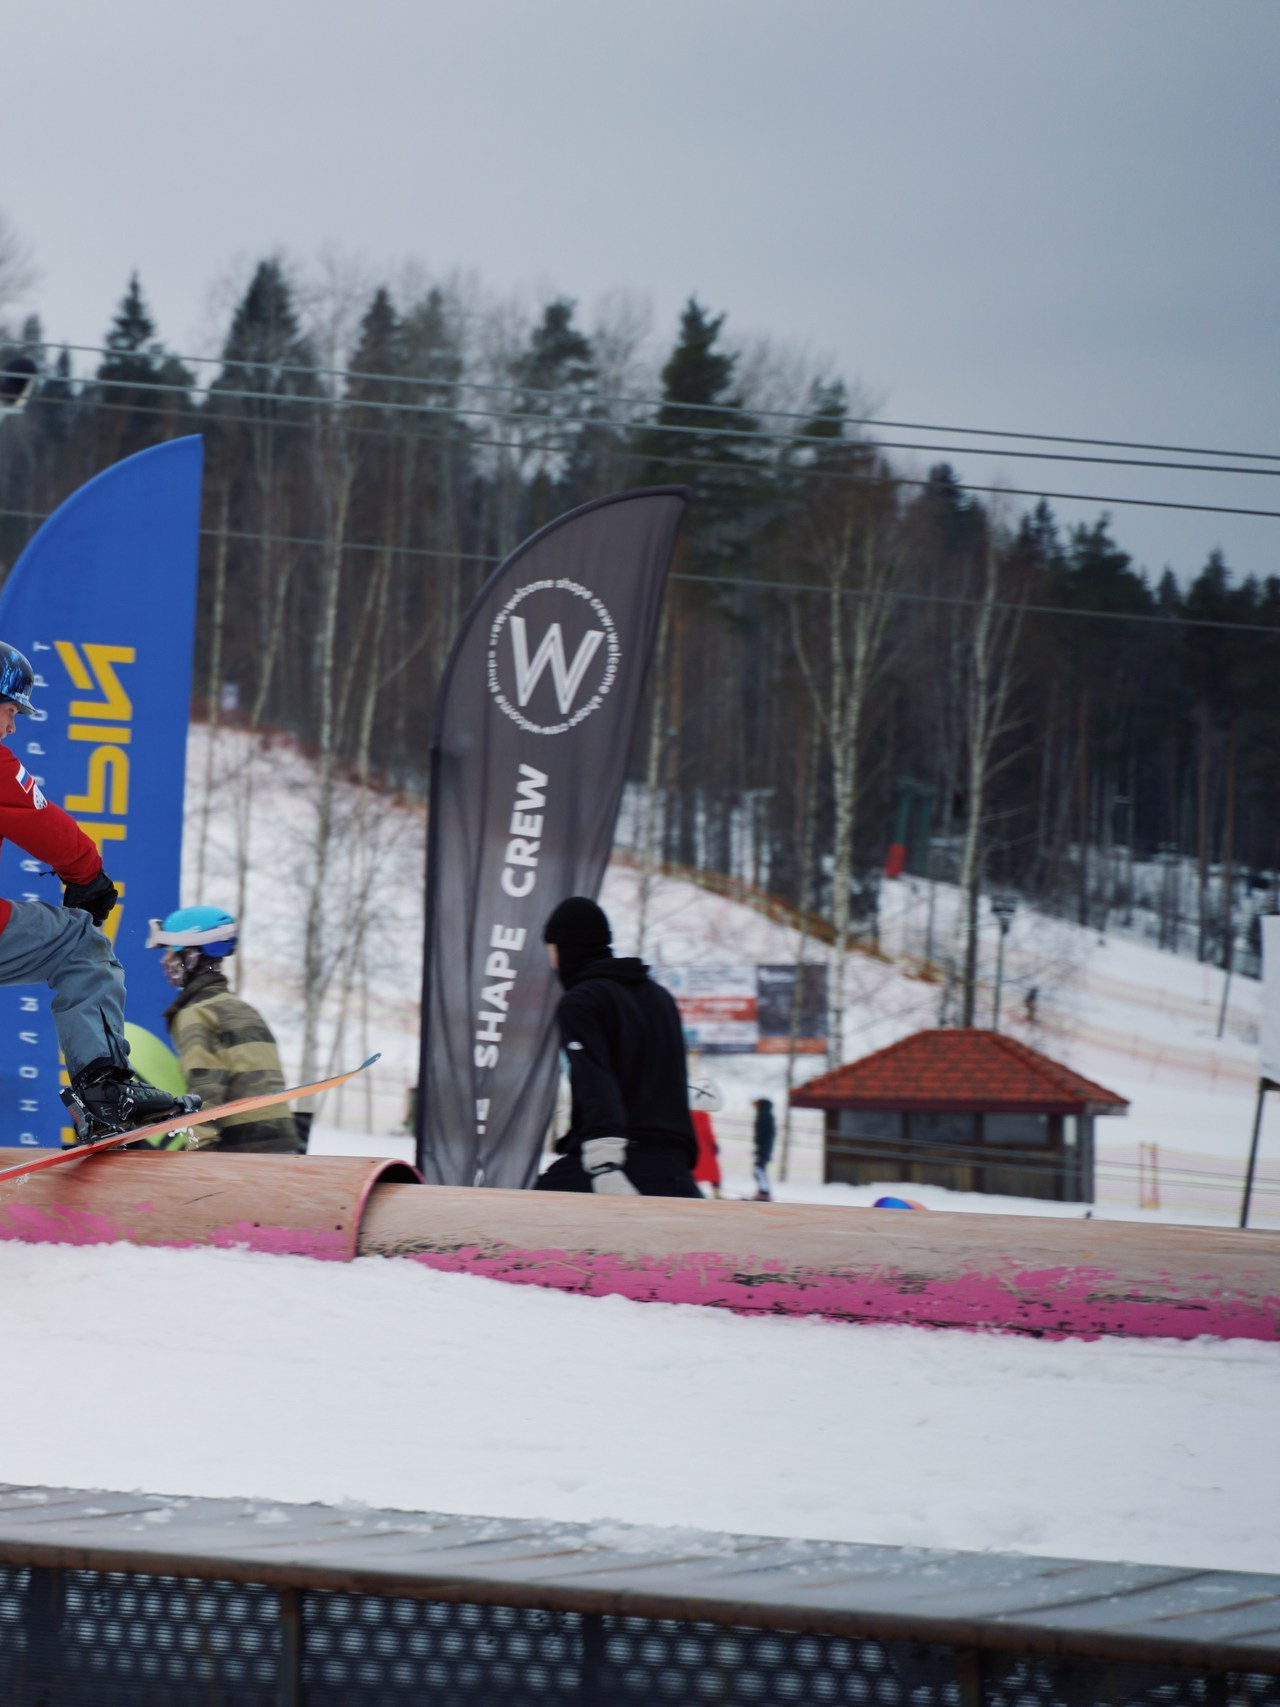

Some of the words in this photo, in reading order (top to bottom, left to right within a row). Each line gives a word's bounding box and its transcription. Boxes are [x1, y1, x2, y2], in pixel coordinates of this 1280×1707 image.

[510, 615, 606, 714] W
[597, 631, 623, 694] welcome
[500, 763, 549, 898] CREW
[474, 924, 527, 1069] SHAPE
